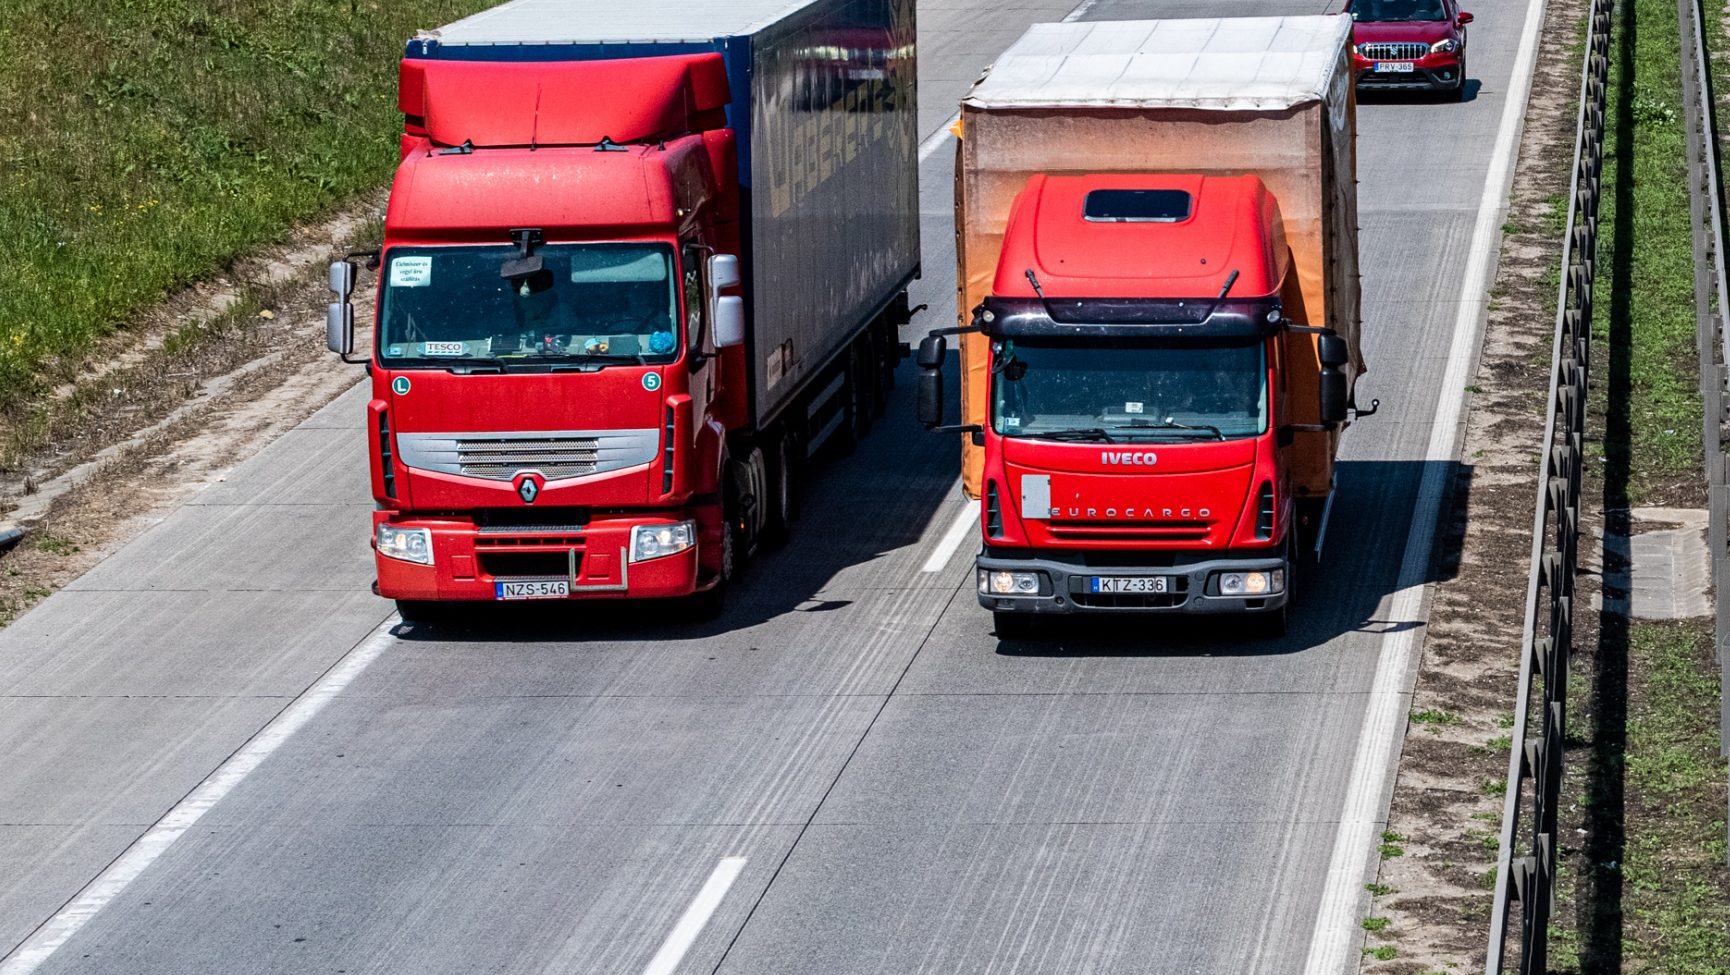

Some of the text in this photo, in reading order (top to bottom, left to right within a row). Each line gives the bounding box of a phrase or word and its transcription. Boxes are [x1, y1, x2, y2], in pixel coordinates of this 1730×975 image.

[427, 343, 461, 351] TESCO
[397, 379, 407, 392] L
[647, 375, 656, 387] 5
[1101, 452, 1157, 465] IVECO
[1051, 507, 1211, 518] EUROCARGO
[506, 583, 566, 596] NZS-546
[1102, 579, 1163, 591] KTZ-336
